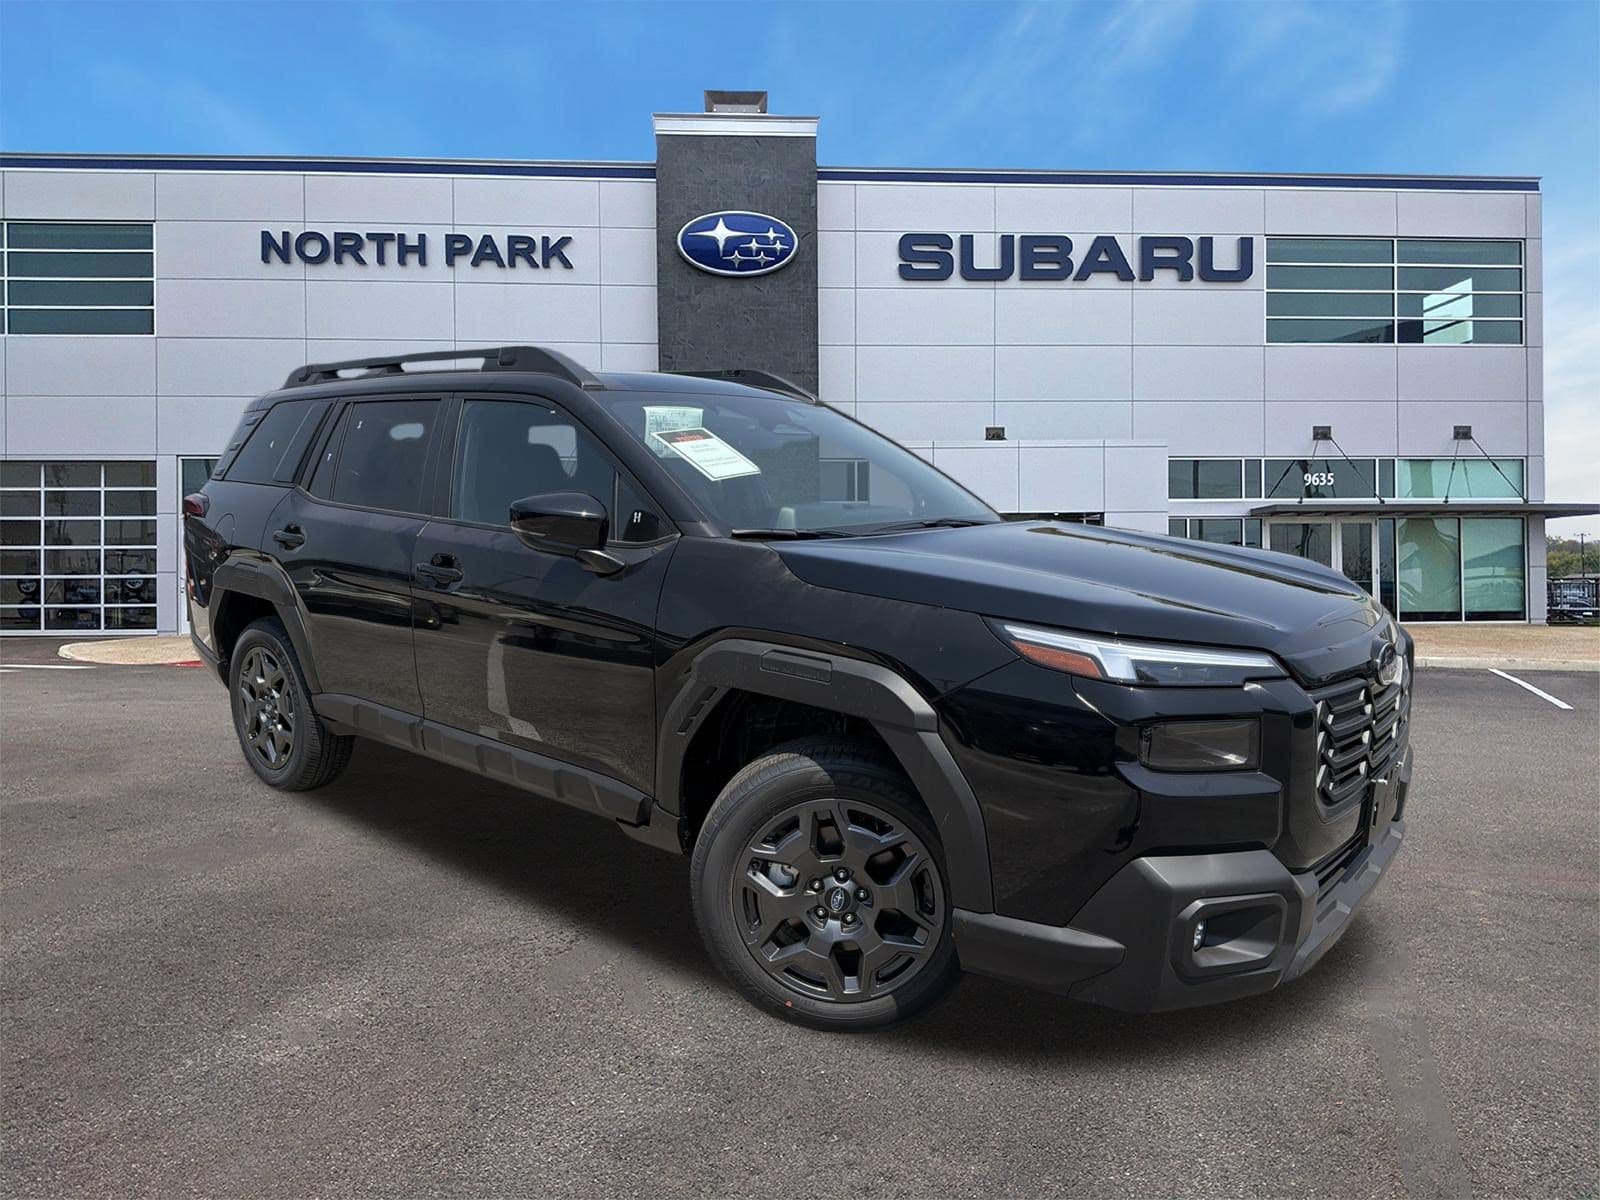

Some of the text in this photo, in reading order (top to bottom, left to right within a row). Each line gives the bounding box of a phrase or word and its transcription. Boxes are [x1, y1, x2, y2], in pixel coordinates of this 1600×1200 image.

[260, 230, 574, 270] NORTH PARK
[898, 233, 1254, 282] SUBARU
[1304, 472, 1335, 487] 9635
